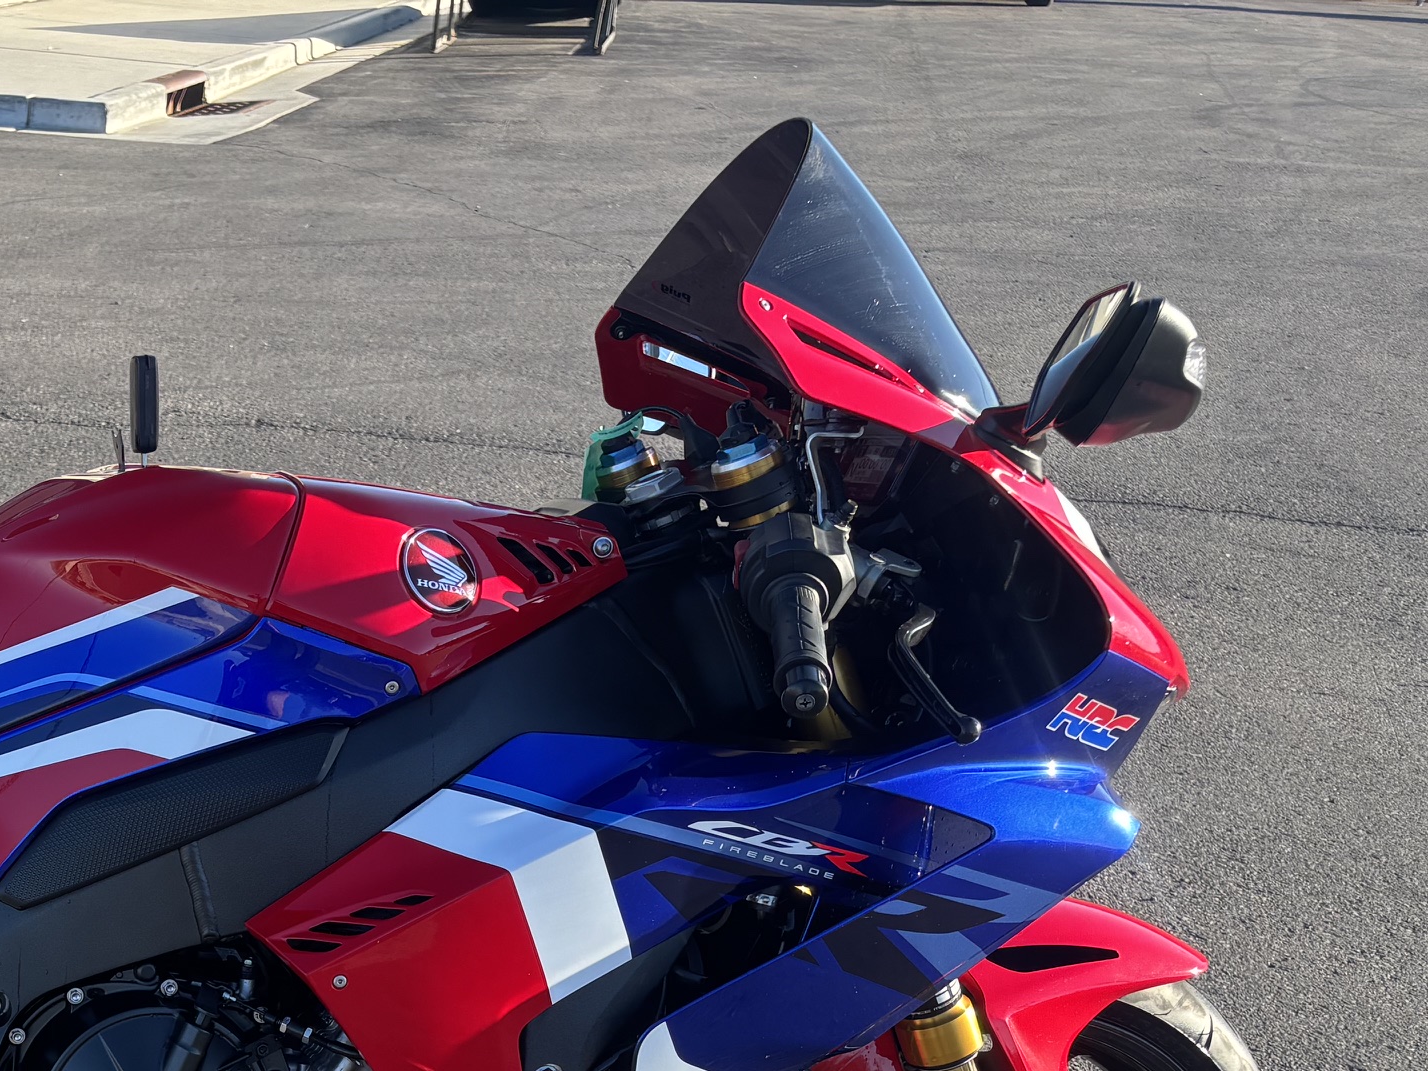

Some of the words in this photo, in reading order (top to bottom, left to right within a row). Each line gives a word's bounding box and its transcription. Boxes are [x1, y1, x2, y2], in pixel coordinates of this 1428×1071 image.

[417, 578, 468, 597] HONDA
[1045, 692, 1140, 751] HRC
[687, 820, 870, 878] CBR
[702, 838, 835, 880] FIREBLADE
